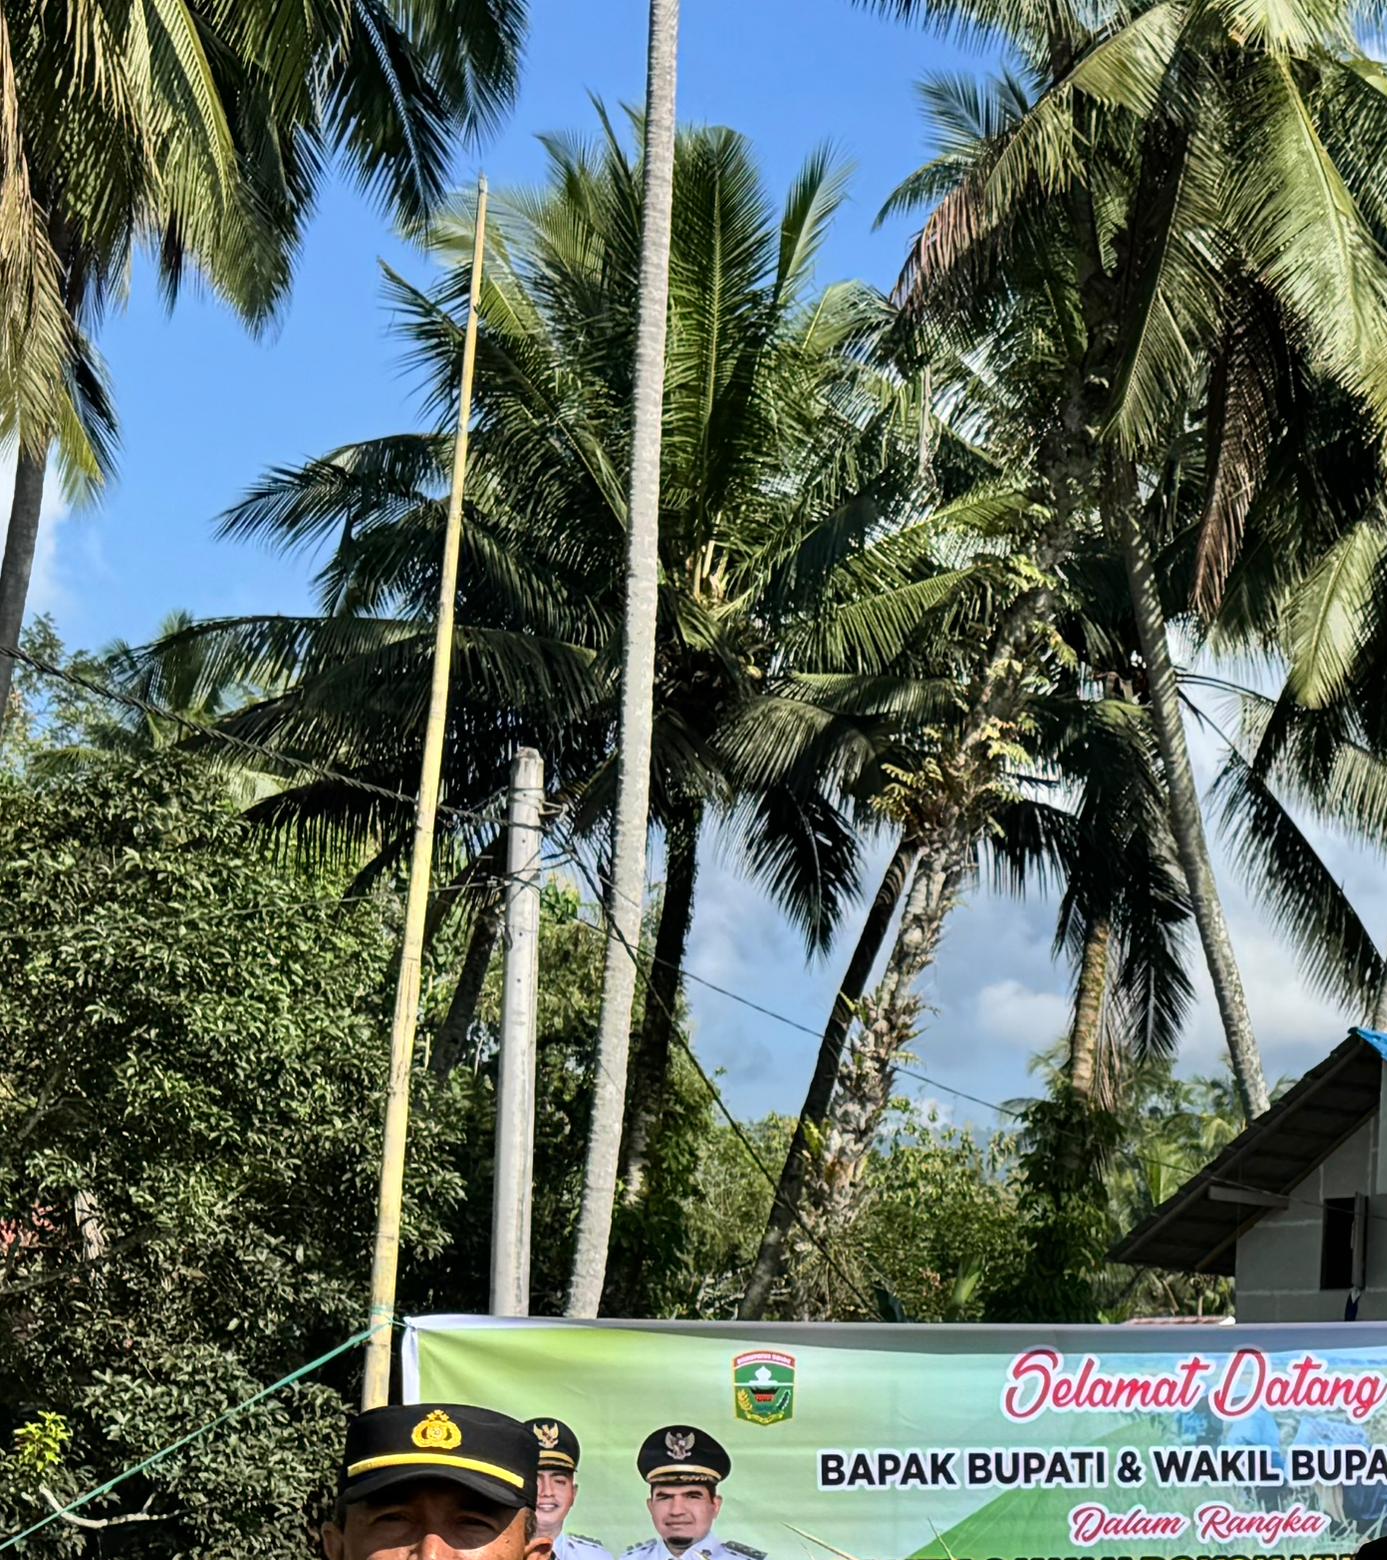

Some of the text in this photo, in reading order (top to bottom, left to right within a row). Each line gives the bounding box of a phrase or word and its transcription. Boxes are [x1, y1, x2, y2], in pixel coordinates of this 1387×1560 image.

[1005, 1347, 1210, 1419] Selamat
[820, 1452, 957, 1486] BAPAK
[968, 1451, 1105, 1485] BUPATI
[1117, 1450, 1142, 1483] &
[1153, 1449, 1281, 1482] WAKIL
[1072, 1504, 1326, 1544] Dalam Rangka
